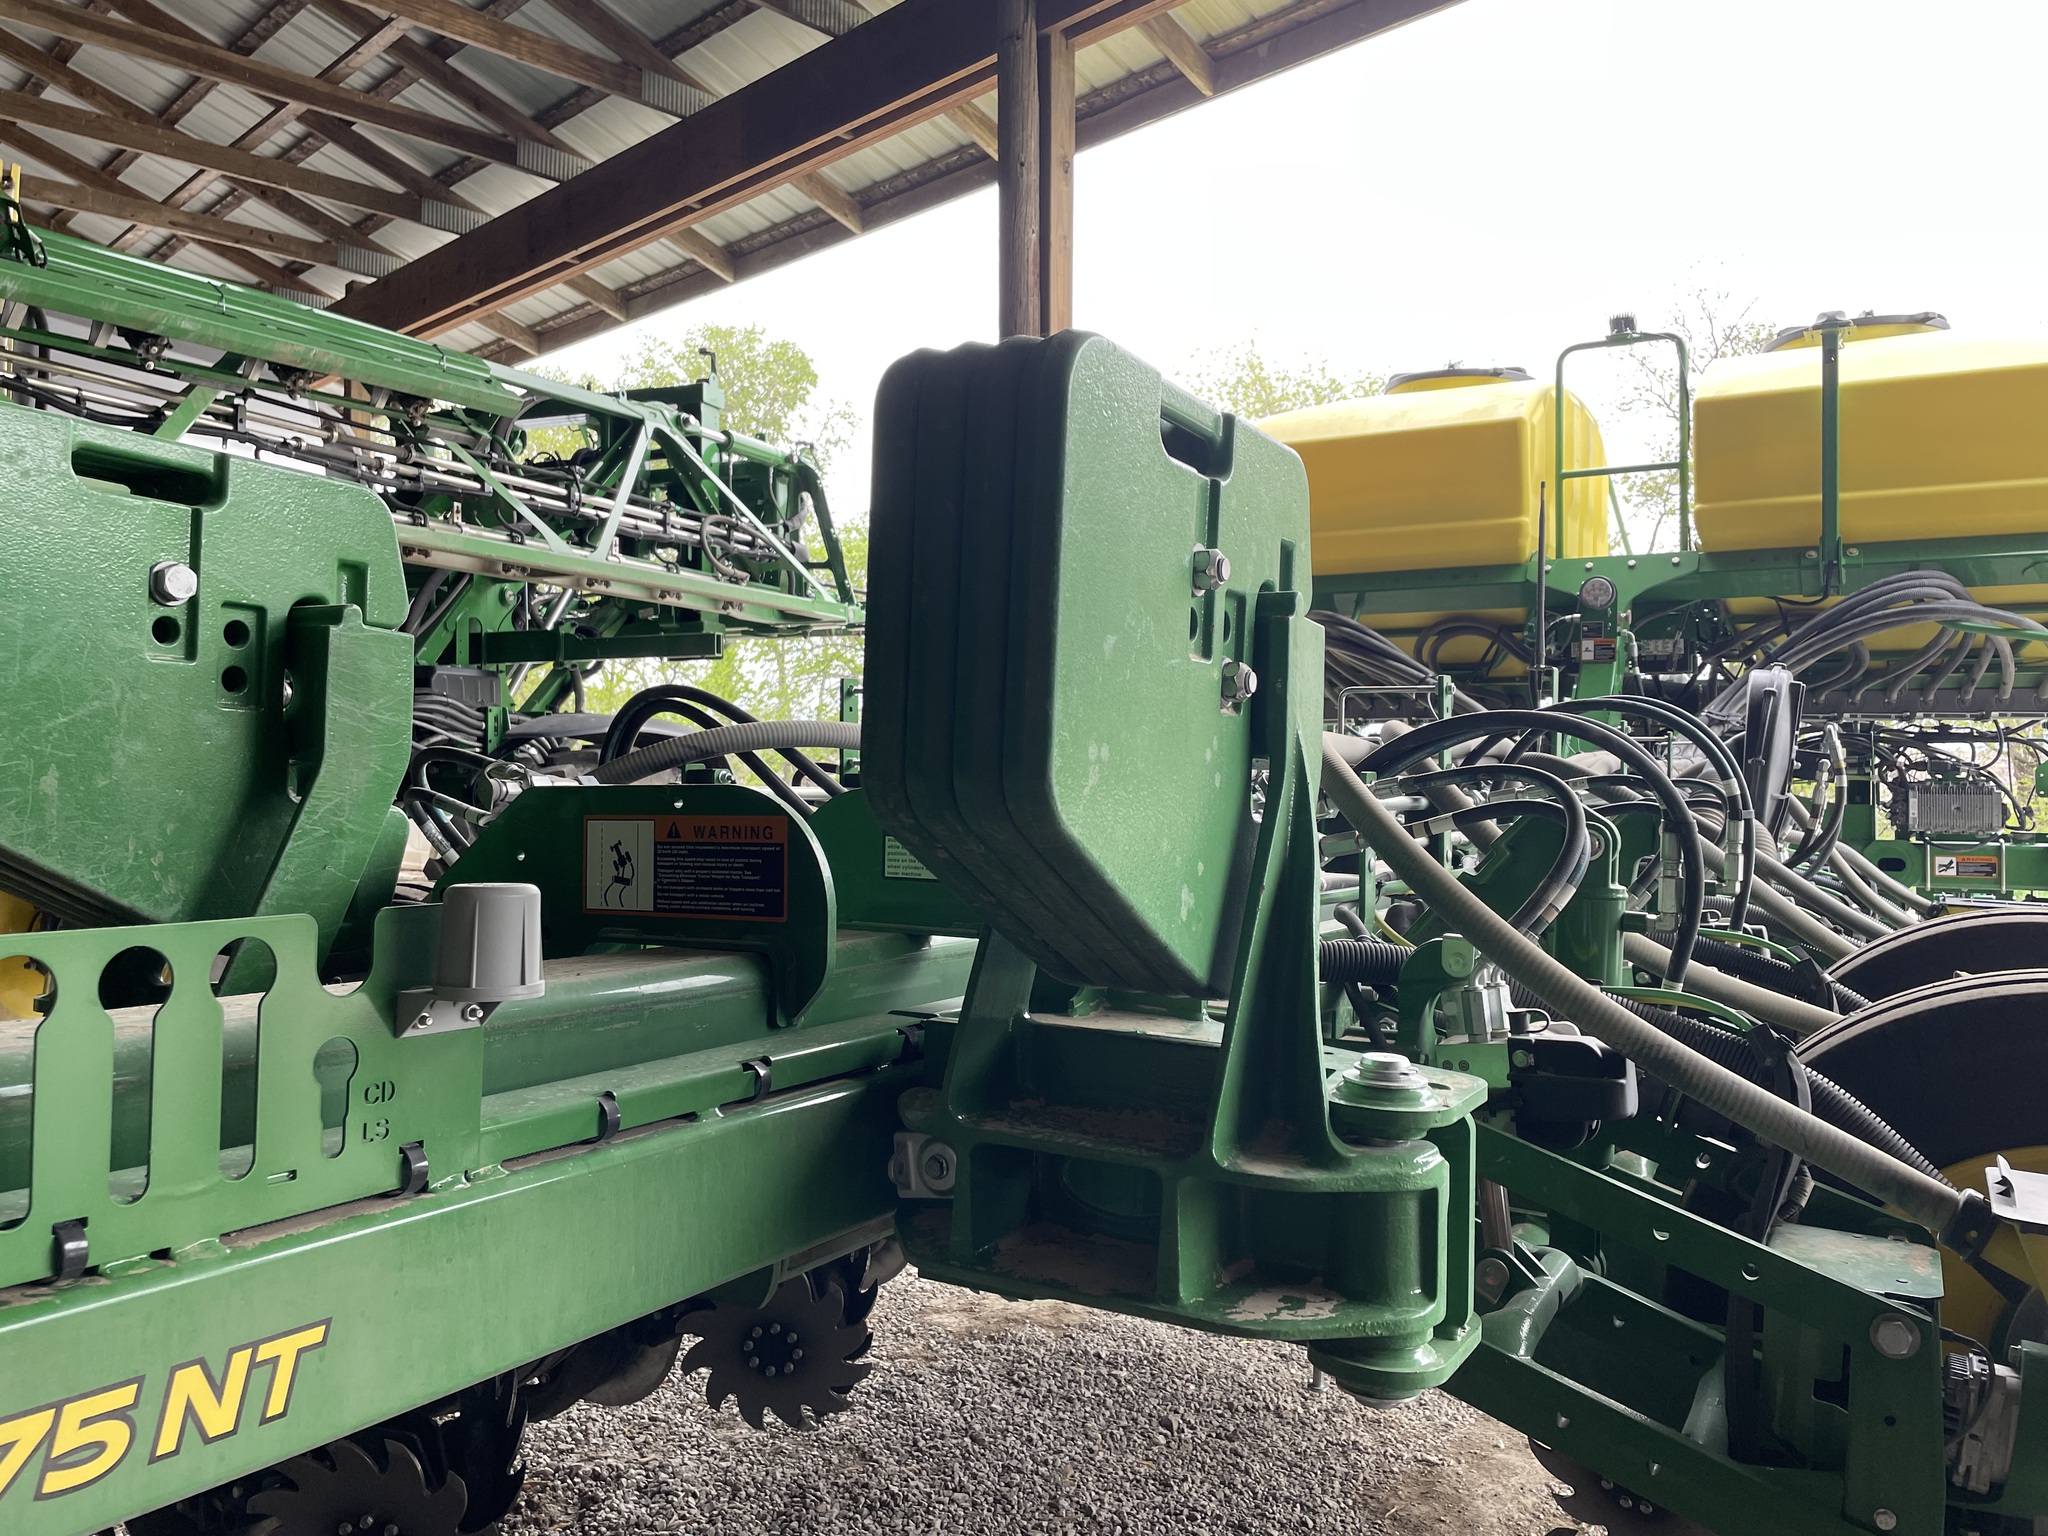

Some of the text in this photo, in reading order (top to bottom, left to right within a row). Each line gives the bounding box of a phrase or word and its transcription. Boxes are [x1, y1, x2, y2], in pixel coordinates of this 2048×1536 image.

[693, 825, 773, 840] WARNING
[364, 1080, 396, 1105] CD
[0, 1316, 333, 1501] 75 NT
